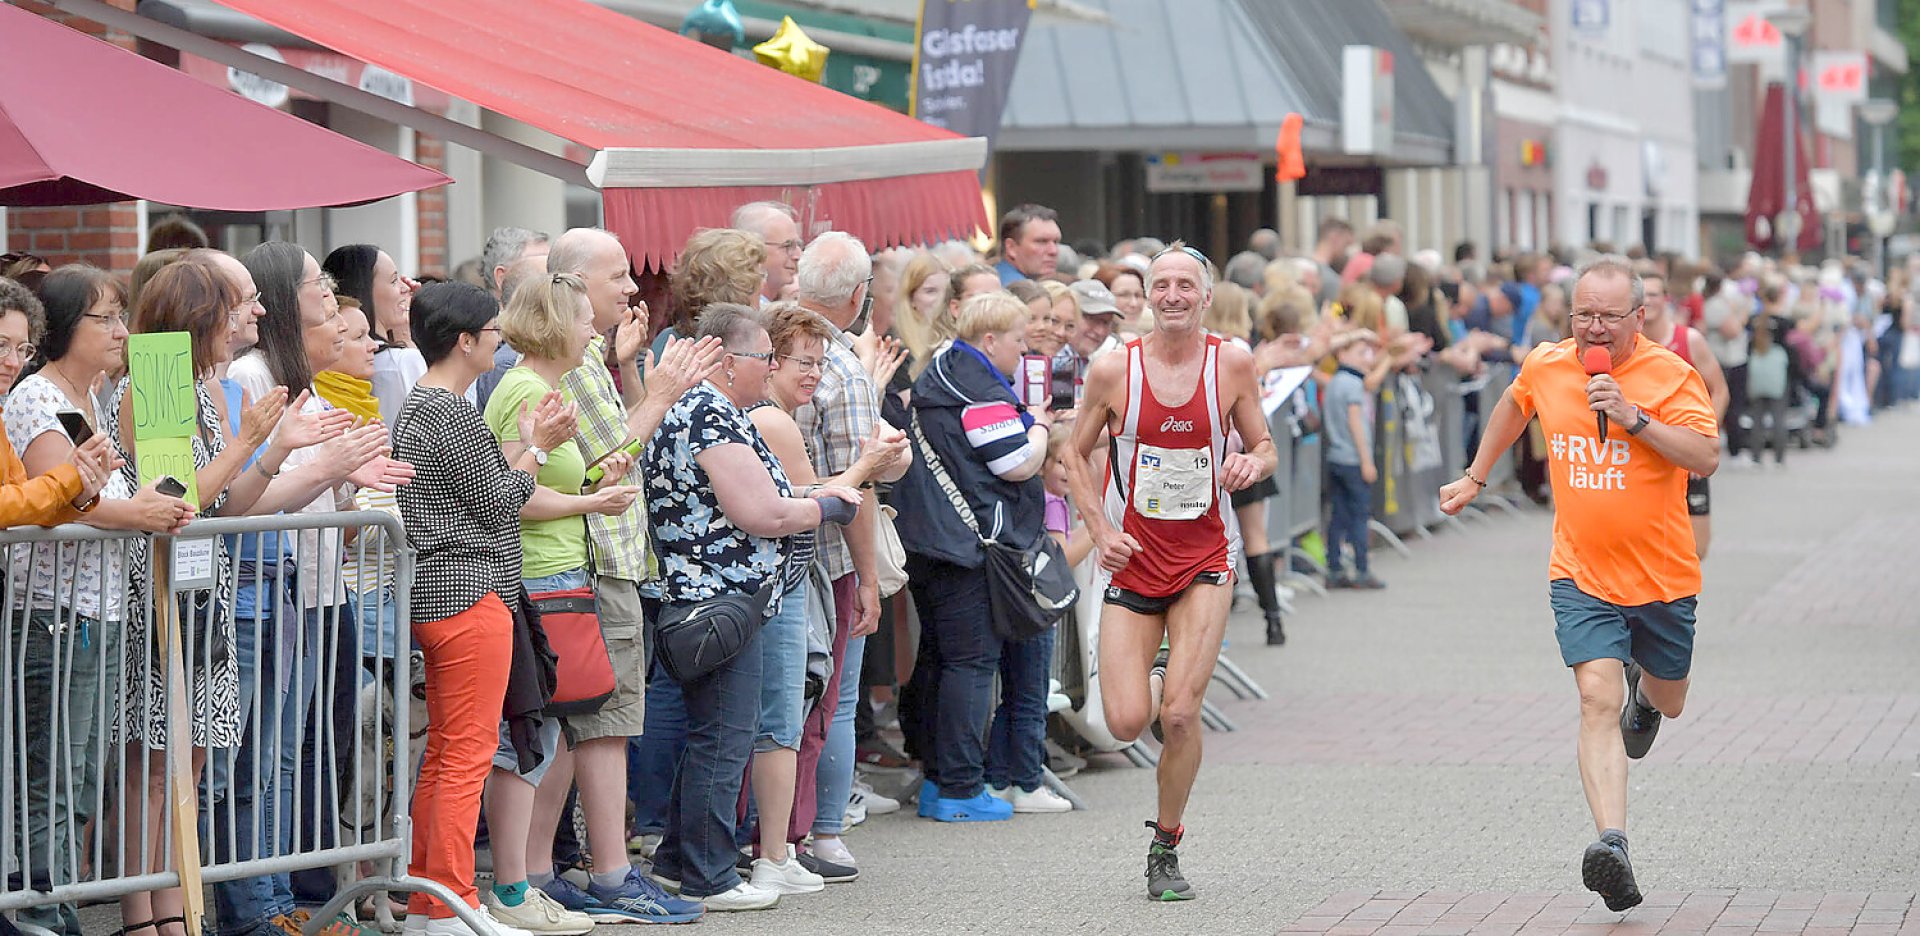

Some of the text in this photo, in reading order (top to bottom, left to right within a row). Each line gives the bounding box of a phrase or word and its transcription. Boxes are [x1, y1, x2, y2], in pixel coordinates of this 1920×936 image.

[922, 24, 1018, 58] Glsfaser
[132, 344, 193, 428] SÖNKE
[1193, 456, 1208, 469] 19
[1550, 433, 1631, 465] #RVB
[1162, 482, 1185, 490] Peter
[1568, 464, 1626, 490] läuft
